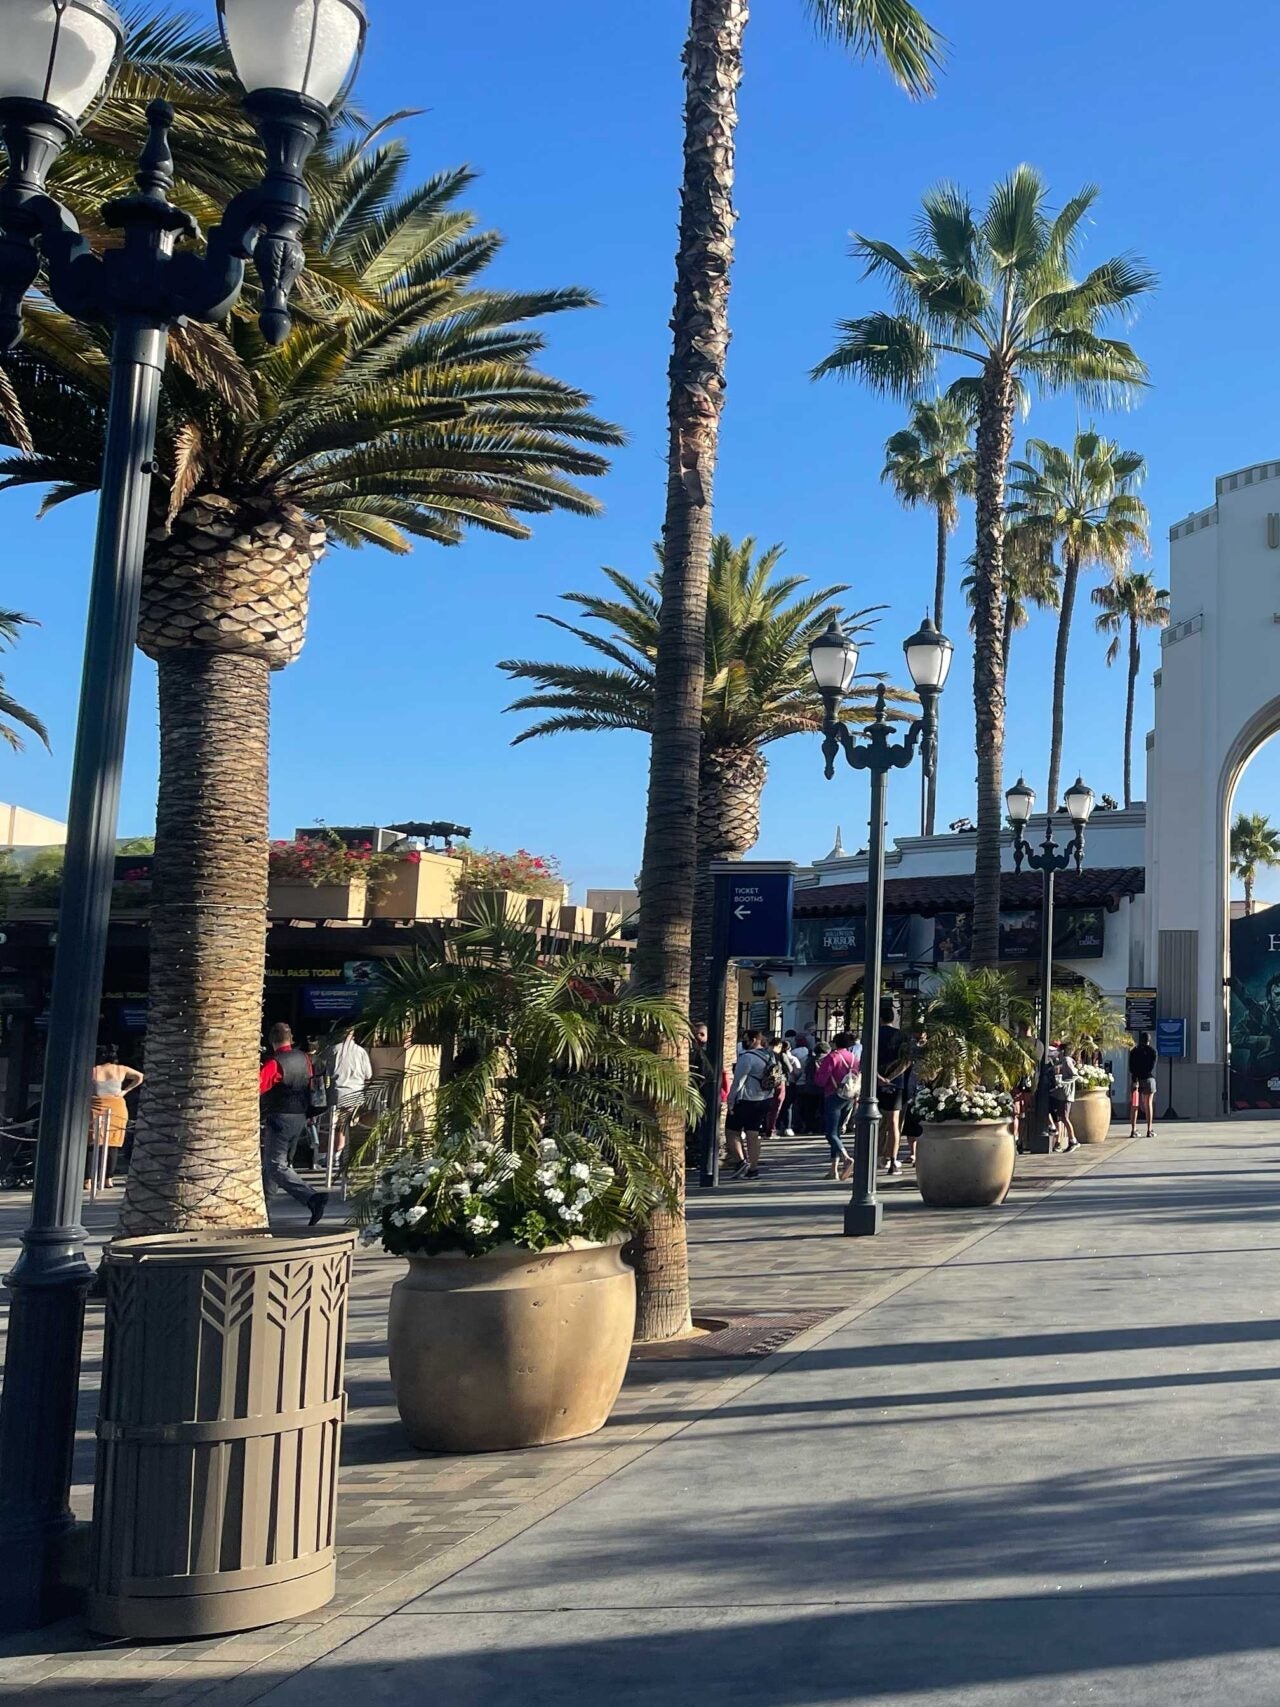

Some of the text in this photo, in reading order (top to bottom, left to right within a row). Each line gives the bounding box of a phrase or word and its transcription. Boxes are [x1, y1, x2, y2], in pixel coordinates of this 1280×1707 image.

[735, 887, 759, 895] TICKET
[733, 895, 764, 903] BOOTHS
[823, 936, 856, 947] HORROR
[287, 969, 310, 977] PASS
[312, 969, 342, 977] TODAY
